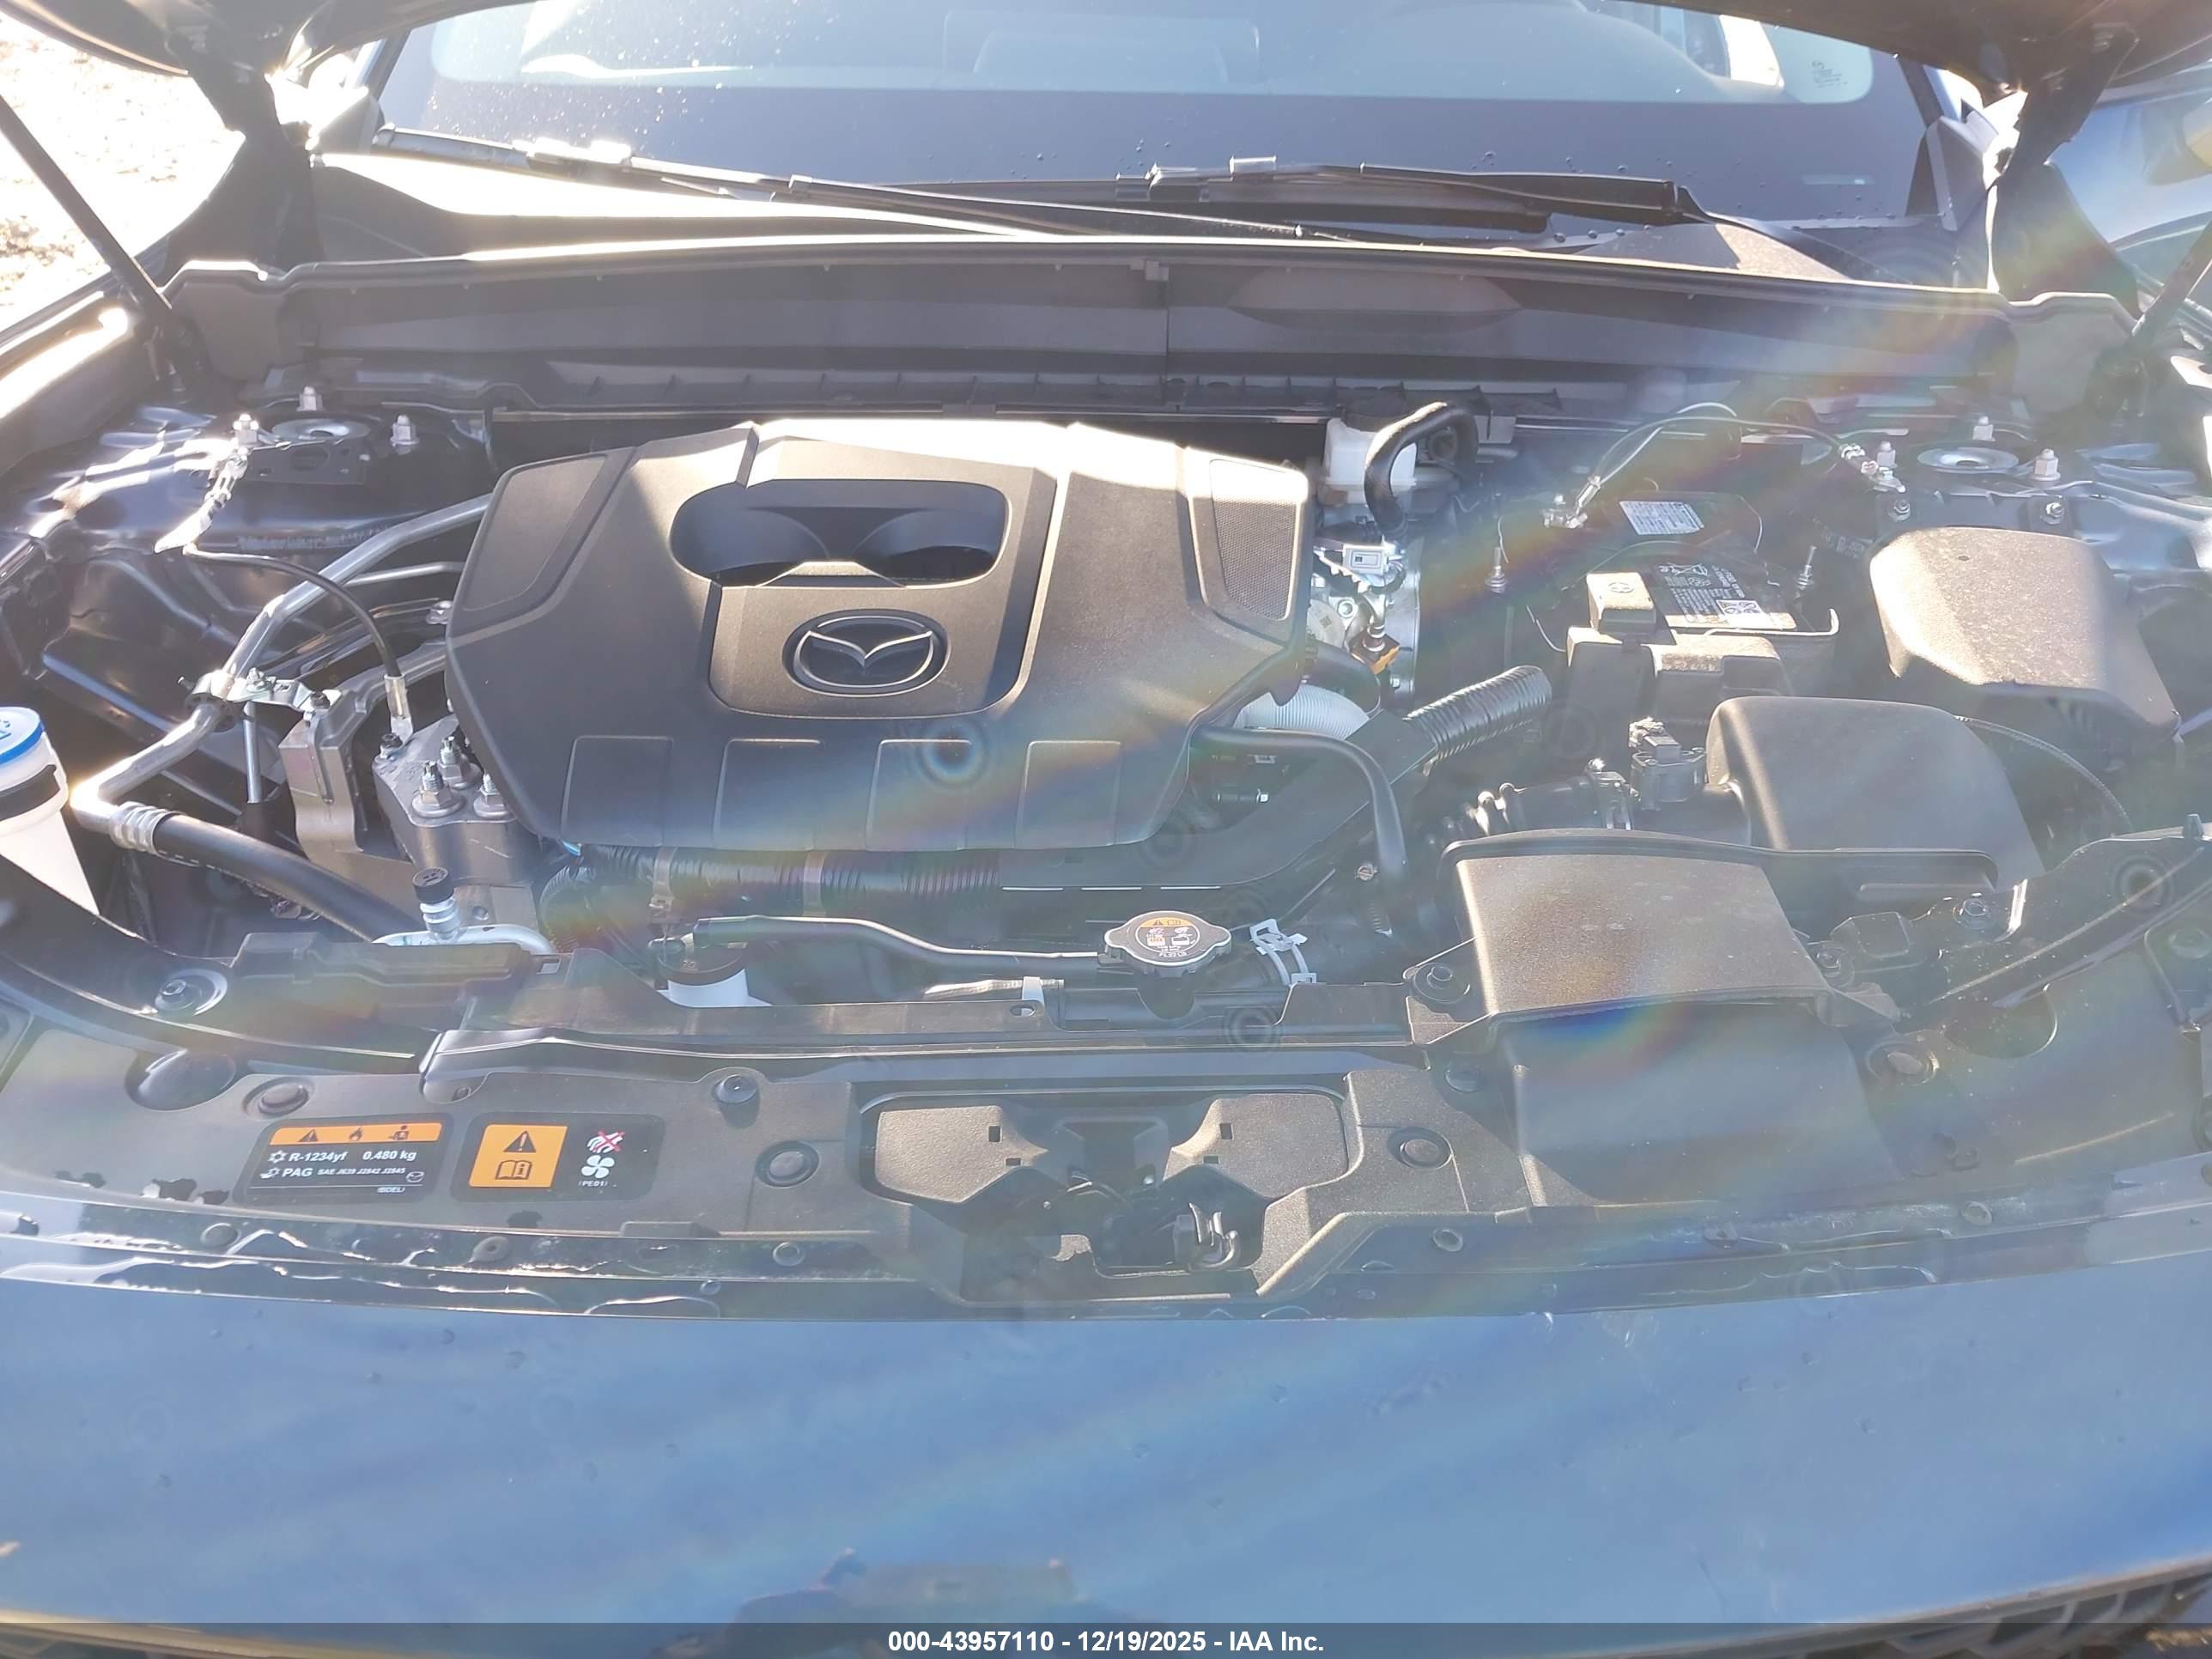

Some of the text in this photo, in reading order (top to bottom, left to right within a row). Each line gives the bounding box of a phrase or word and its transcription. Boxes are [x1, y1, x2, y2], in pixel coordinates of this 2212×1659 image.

[288, 1150, 417, 1163] R-1234yf 0.480 kg
[282, 1167, 313, 1178] PAG
